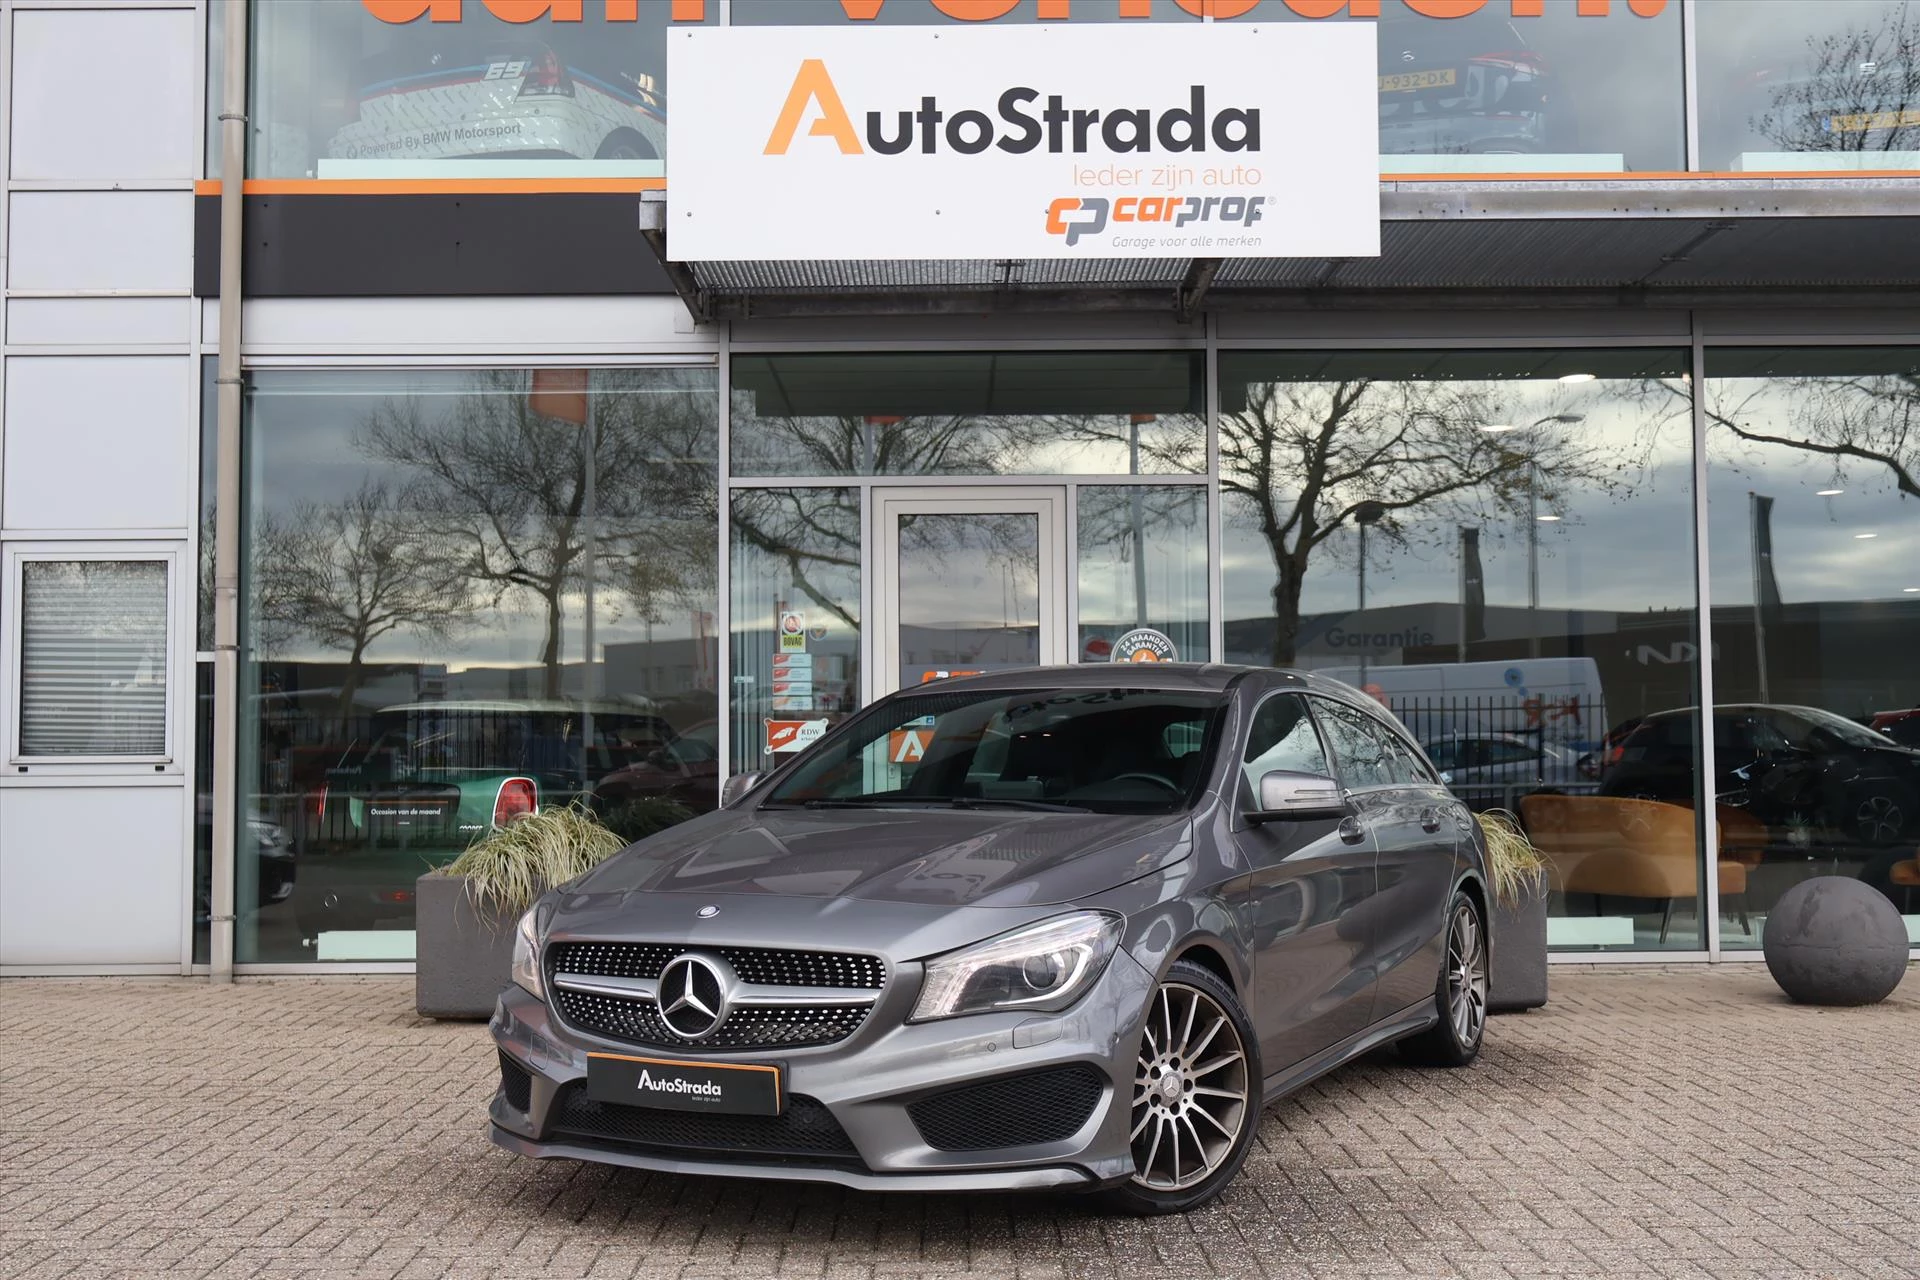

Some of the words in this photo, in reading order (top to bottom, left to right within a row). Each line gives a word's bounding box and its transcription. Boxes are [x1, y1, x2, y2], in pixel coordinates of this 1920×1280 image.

[763, 58, 1261, 155] AutoStrada
[360, 140, 402, 154] Powered
[405, 136, 420, 149] By
[423, 130, 451, 145] BMW
[454, 123, 522, 141] Motorsport
[1073, 164, 1142, 187] Ieder
[1151, 164, 1194, 192] zijn
[1202, 166, 1262, 187] auto
[1112, 236, 1155, 250] Garage
[1160, 238, 1188, 248] voor
[1190, 235, 1211, 248] alle
[1215, 236, 1262, 248] merken
[1126, 641, 1163, 656] GARANTIE
[1131, 634, 1167, 652] MAANDEN
[1325, 626, 1435, 649] Garantie
[371, 808, 397, 816] Occasion
[410, 808, 418, 816] de
[418, 808, 441, 816] maand
[638, 1069, 722, 1096] AutoStrada
